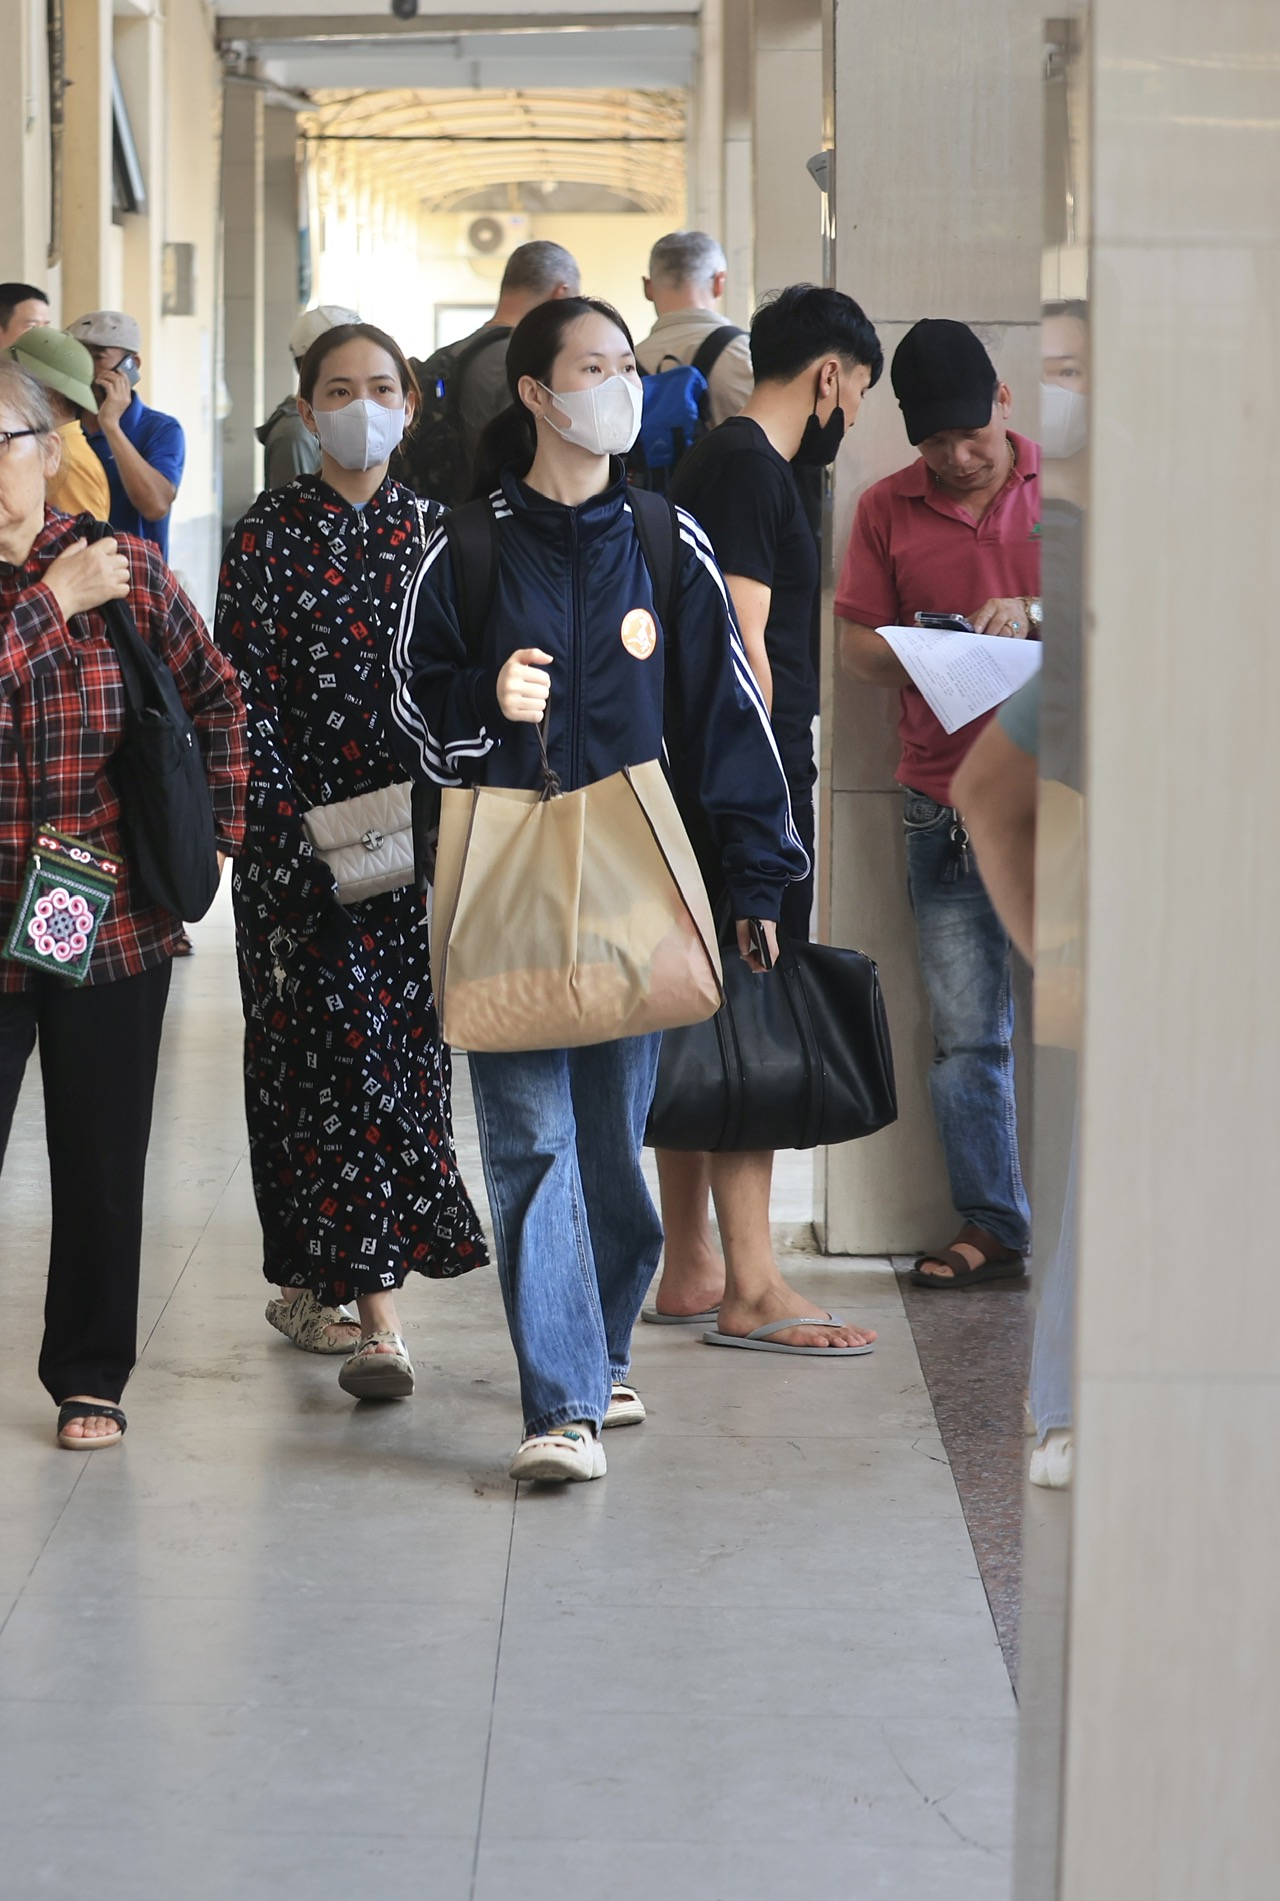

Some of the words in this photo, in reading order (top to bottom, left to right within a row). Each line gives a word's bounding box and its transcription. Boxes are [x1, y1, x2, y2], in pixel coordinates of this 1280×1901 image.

[379, 552, 396, 561] FENDI
[311, 623, 331, 635] FENDI
[248, 643, 265, 658] FENDI
[360, 651, 378, 660] FENDI
[360, 662, 372, 681] FENDI
[344, 693, 363, 705] FENDI
[251, 781, 270, 789] FENDI
[353, 778, 372, 792] FENDI
[318, 967, 336, 981] FENDI
[334, 1055, 354, 1065] FENDI
[351, 1262, 370, 1271] FENDI
